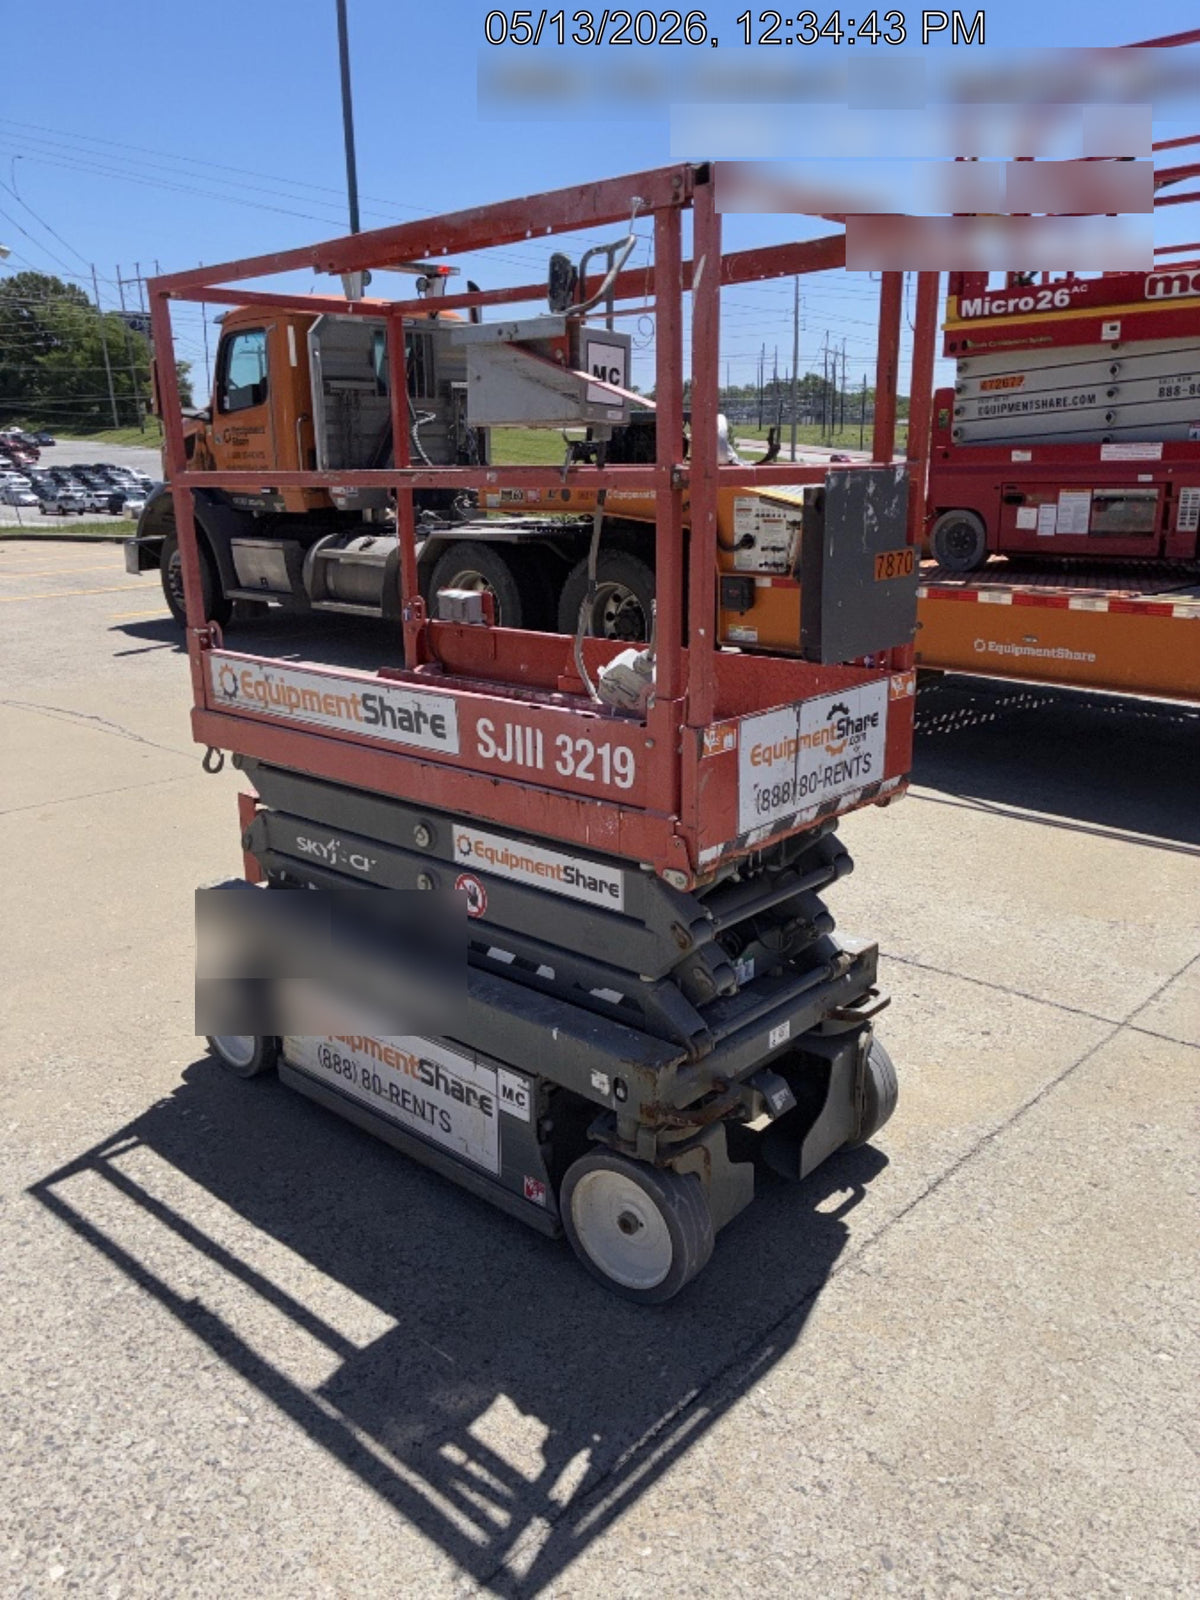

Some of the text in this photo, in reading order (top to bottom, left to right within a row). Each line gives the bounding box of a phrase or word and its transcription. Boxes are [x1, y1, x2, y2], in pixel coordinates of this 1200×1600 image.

[961, 288, 1070, 318] Micro26
[593, 364, 620, 386] MC
[978, 394, 1096, 416] EQUIPMENTSHARE.COM
[876, 551, 912, 579] 7870
[987, 641, 1096, 662] EquipmentShare
[240, 671, 447, 740] EquipmentShare
[750, 711, 879, 767] EquipmentShare
[555, 734, 635, 789] 3219
[474, 840, 620, 898] EquipmentShare
[327, 1035, 493, 1118] pmentShare
[502, 1084, 526, 1106] MC
